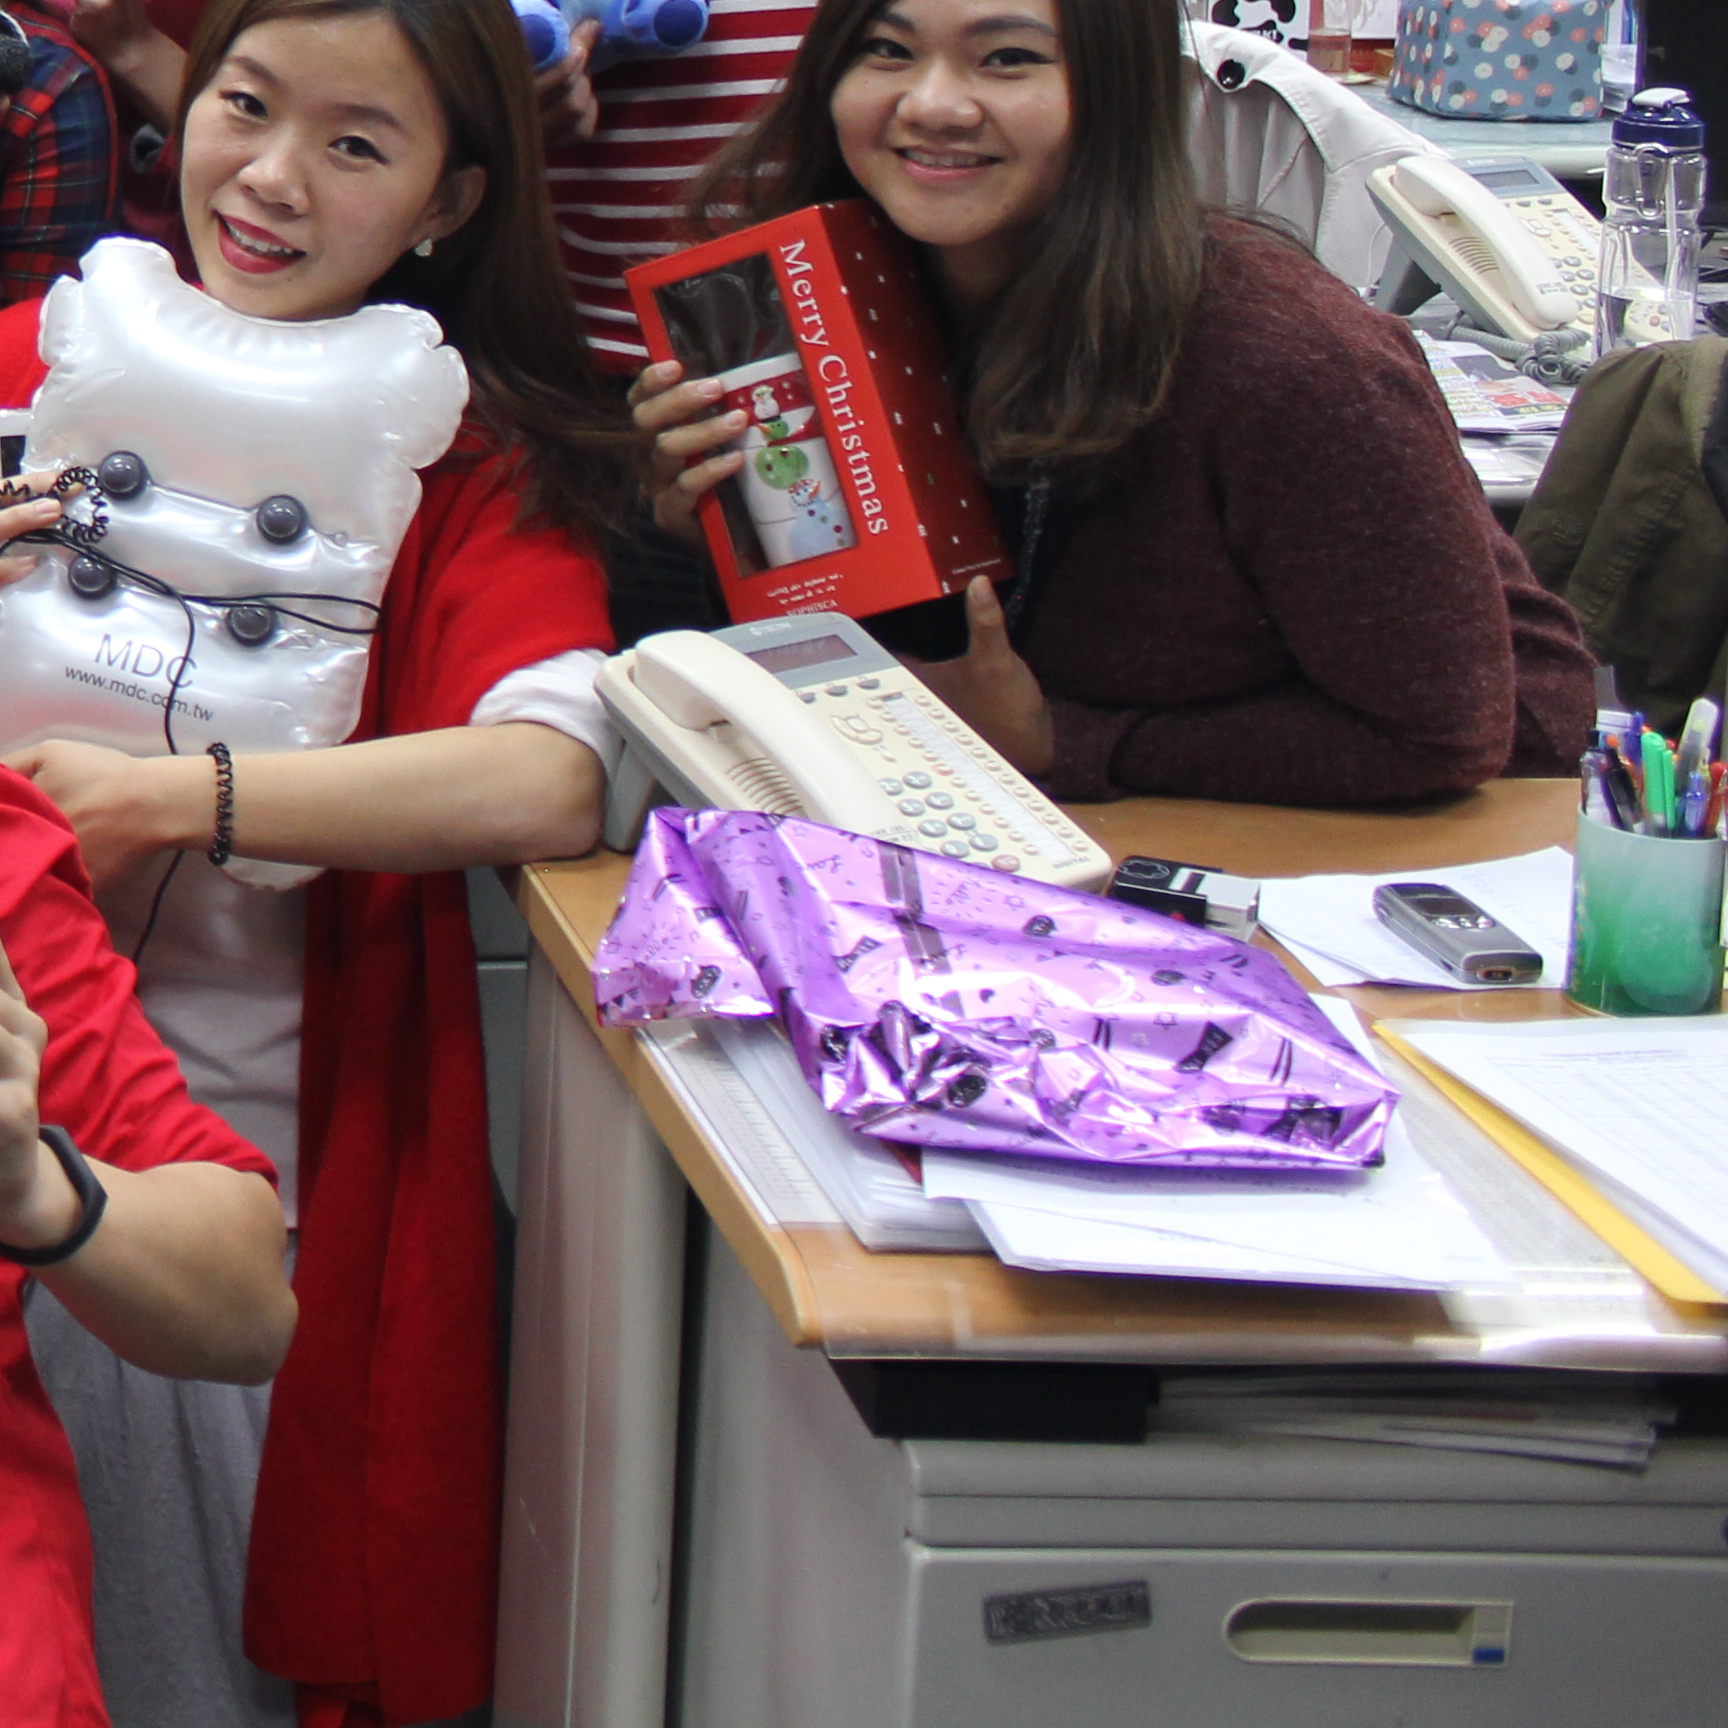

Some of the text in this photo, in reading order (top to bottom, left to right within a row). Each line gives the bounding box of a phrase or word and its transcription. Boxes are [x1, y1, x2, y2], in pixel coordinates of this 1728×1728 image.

[780, 239, 889, 536] Merry Christmas
[94, 633, 198, 689] MDC
[64, 665, 214, 722] www.mdc.com.tw
